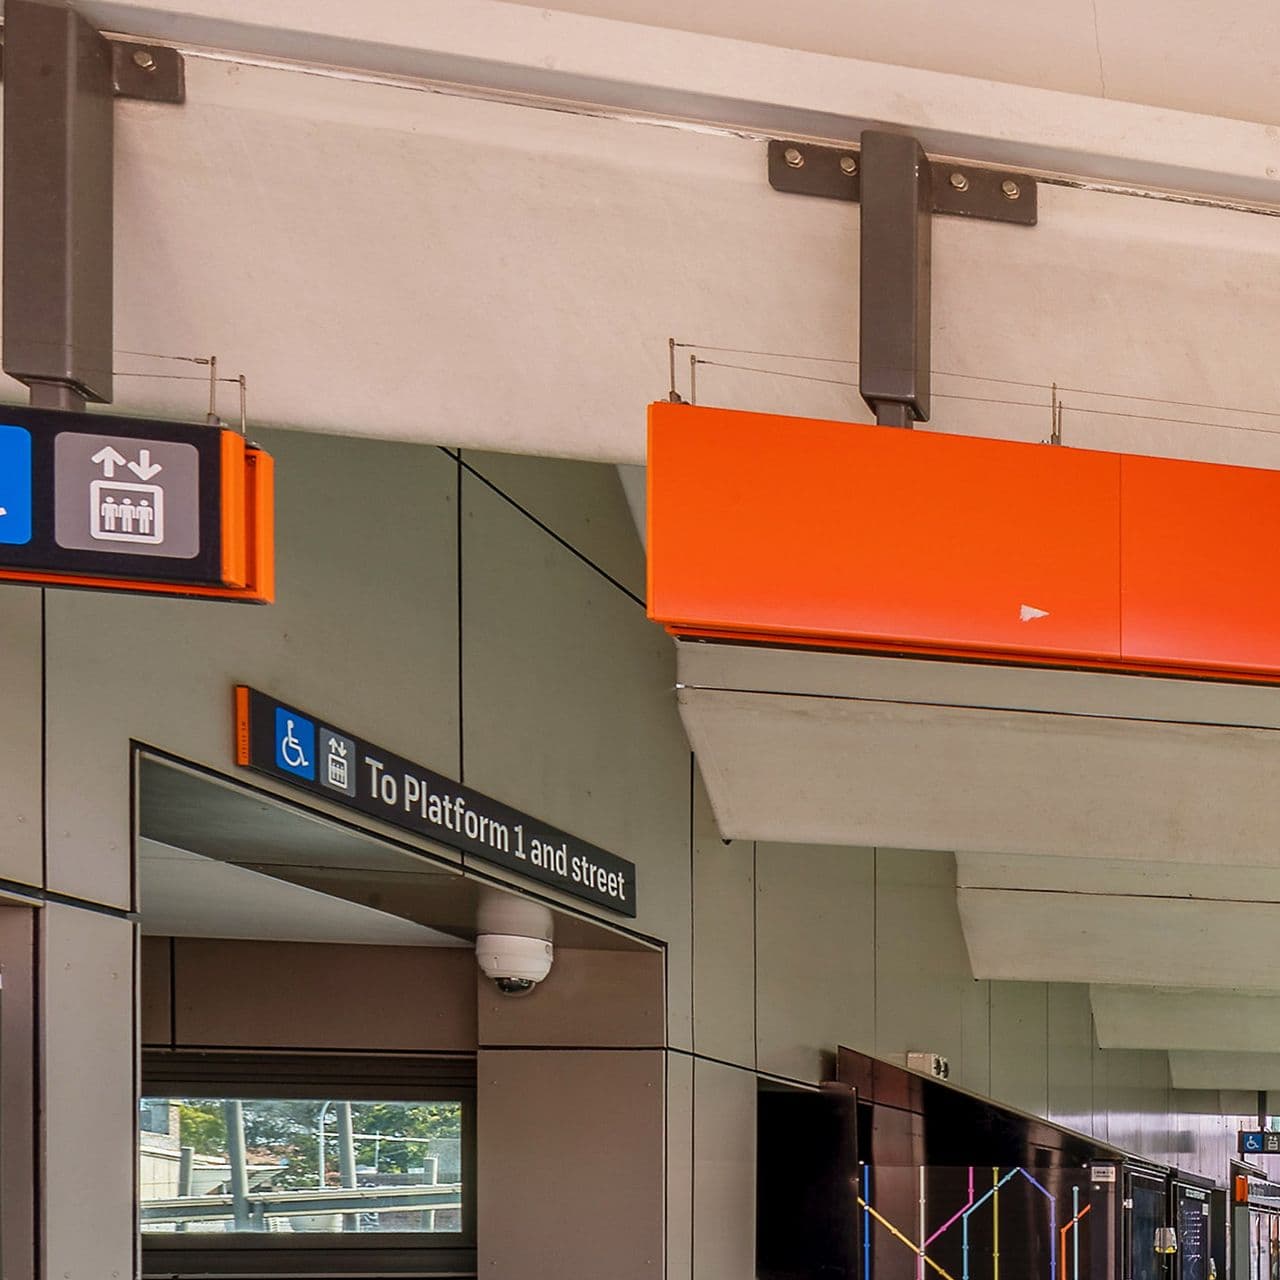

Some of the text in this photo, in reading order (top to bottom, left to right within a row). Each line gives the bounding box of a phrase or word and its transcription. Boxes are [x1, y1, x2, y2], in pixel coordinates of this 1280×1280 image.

[365, 756, 626, 901] To Platform 1 and street
